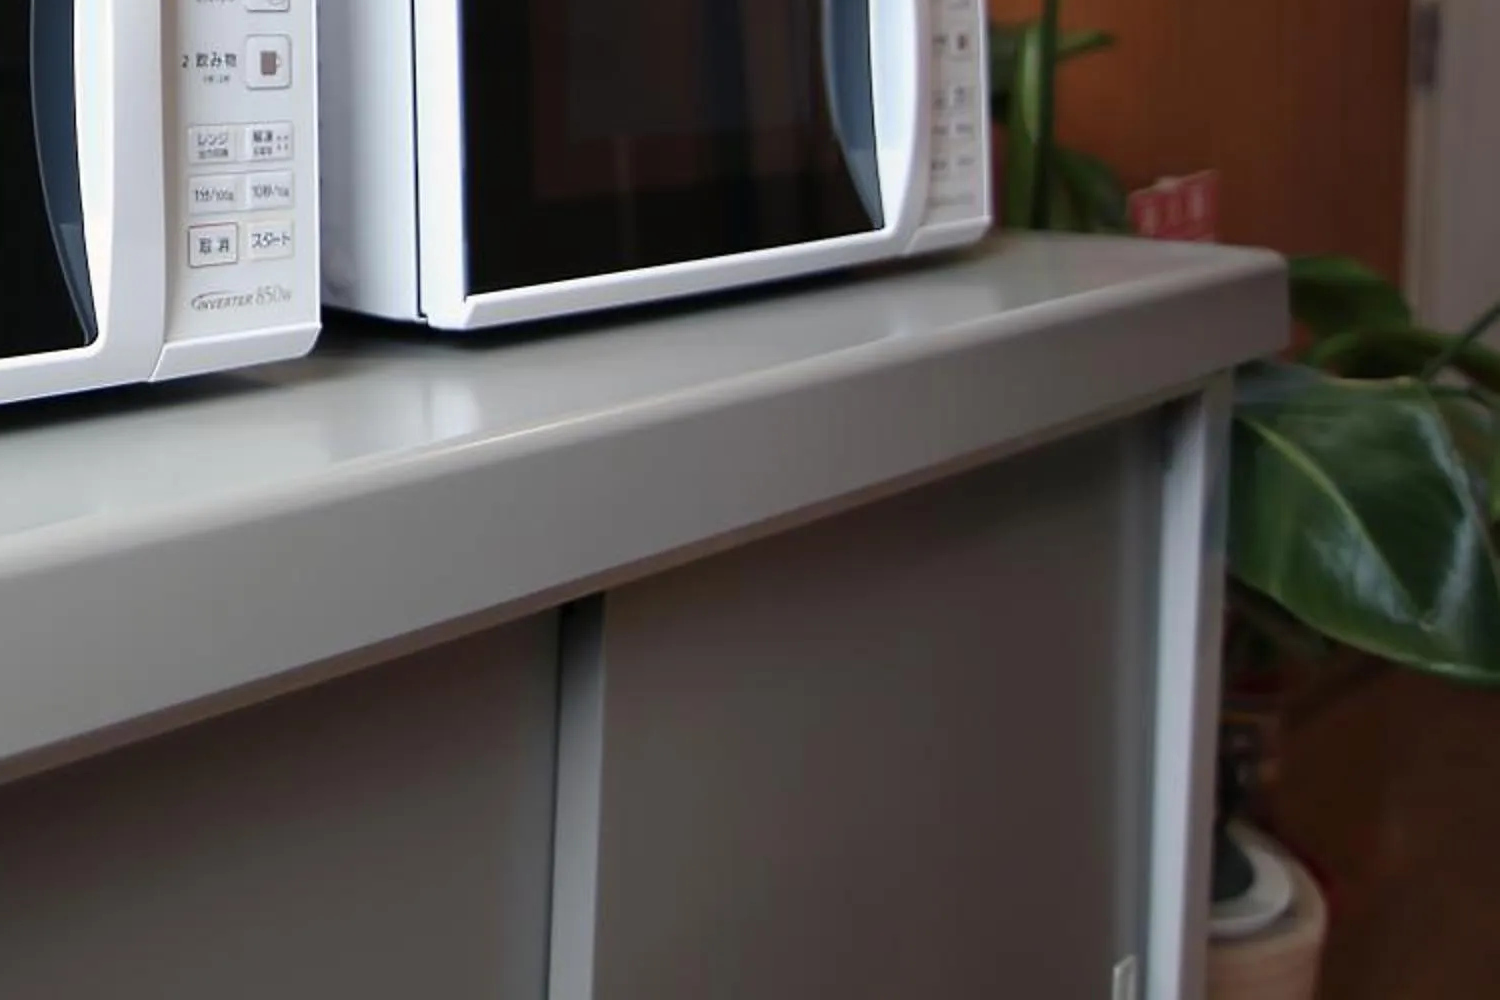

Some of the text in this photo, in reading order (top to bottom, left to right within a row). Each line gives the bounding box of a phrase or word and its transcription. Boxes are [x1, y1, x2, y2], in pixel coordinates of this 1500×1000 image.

[196, 52, 237, 68] 飲み物
[251, 231, 290, 248] スタート
